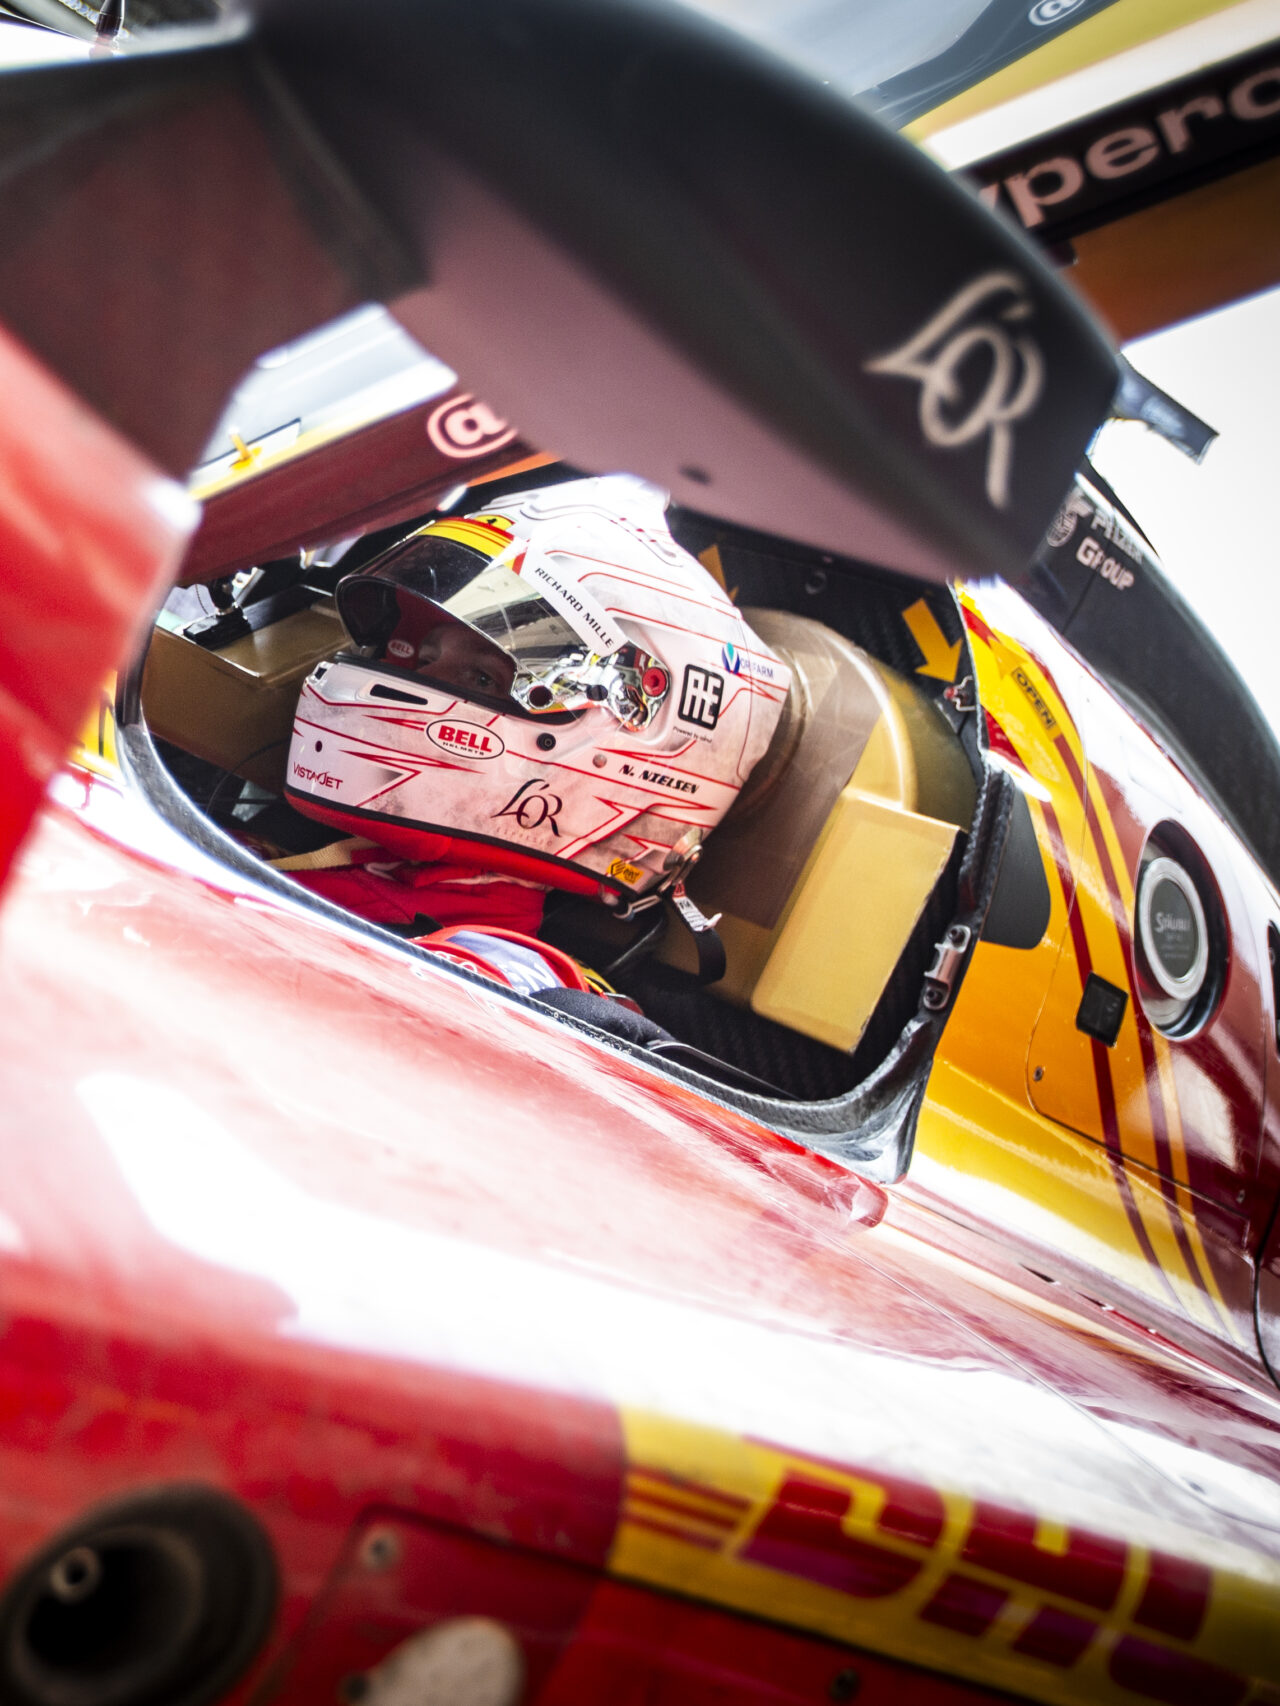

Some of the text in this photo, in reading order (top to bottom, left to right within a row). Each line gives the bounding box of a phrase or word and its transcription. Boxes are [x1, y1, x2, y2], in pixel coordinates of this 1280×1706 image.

[534, 567, 615, 649] RICHARD MILLE
[1016, 673, 1054, 725] OPEN
[437, 724, 493, 753] BELL
[618, 763, 700, 794] N. NIELSEN
